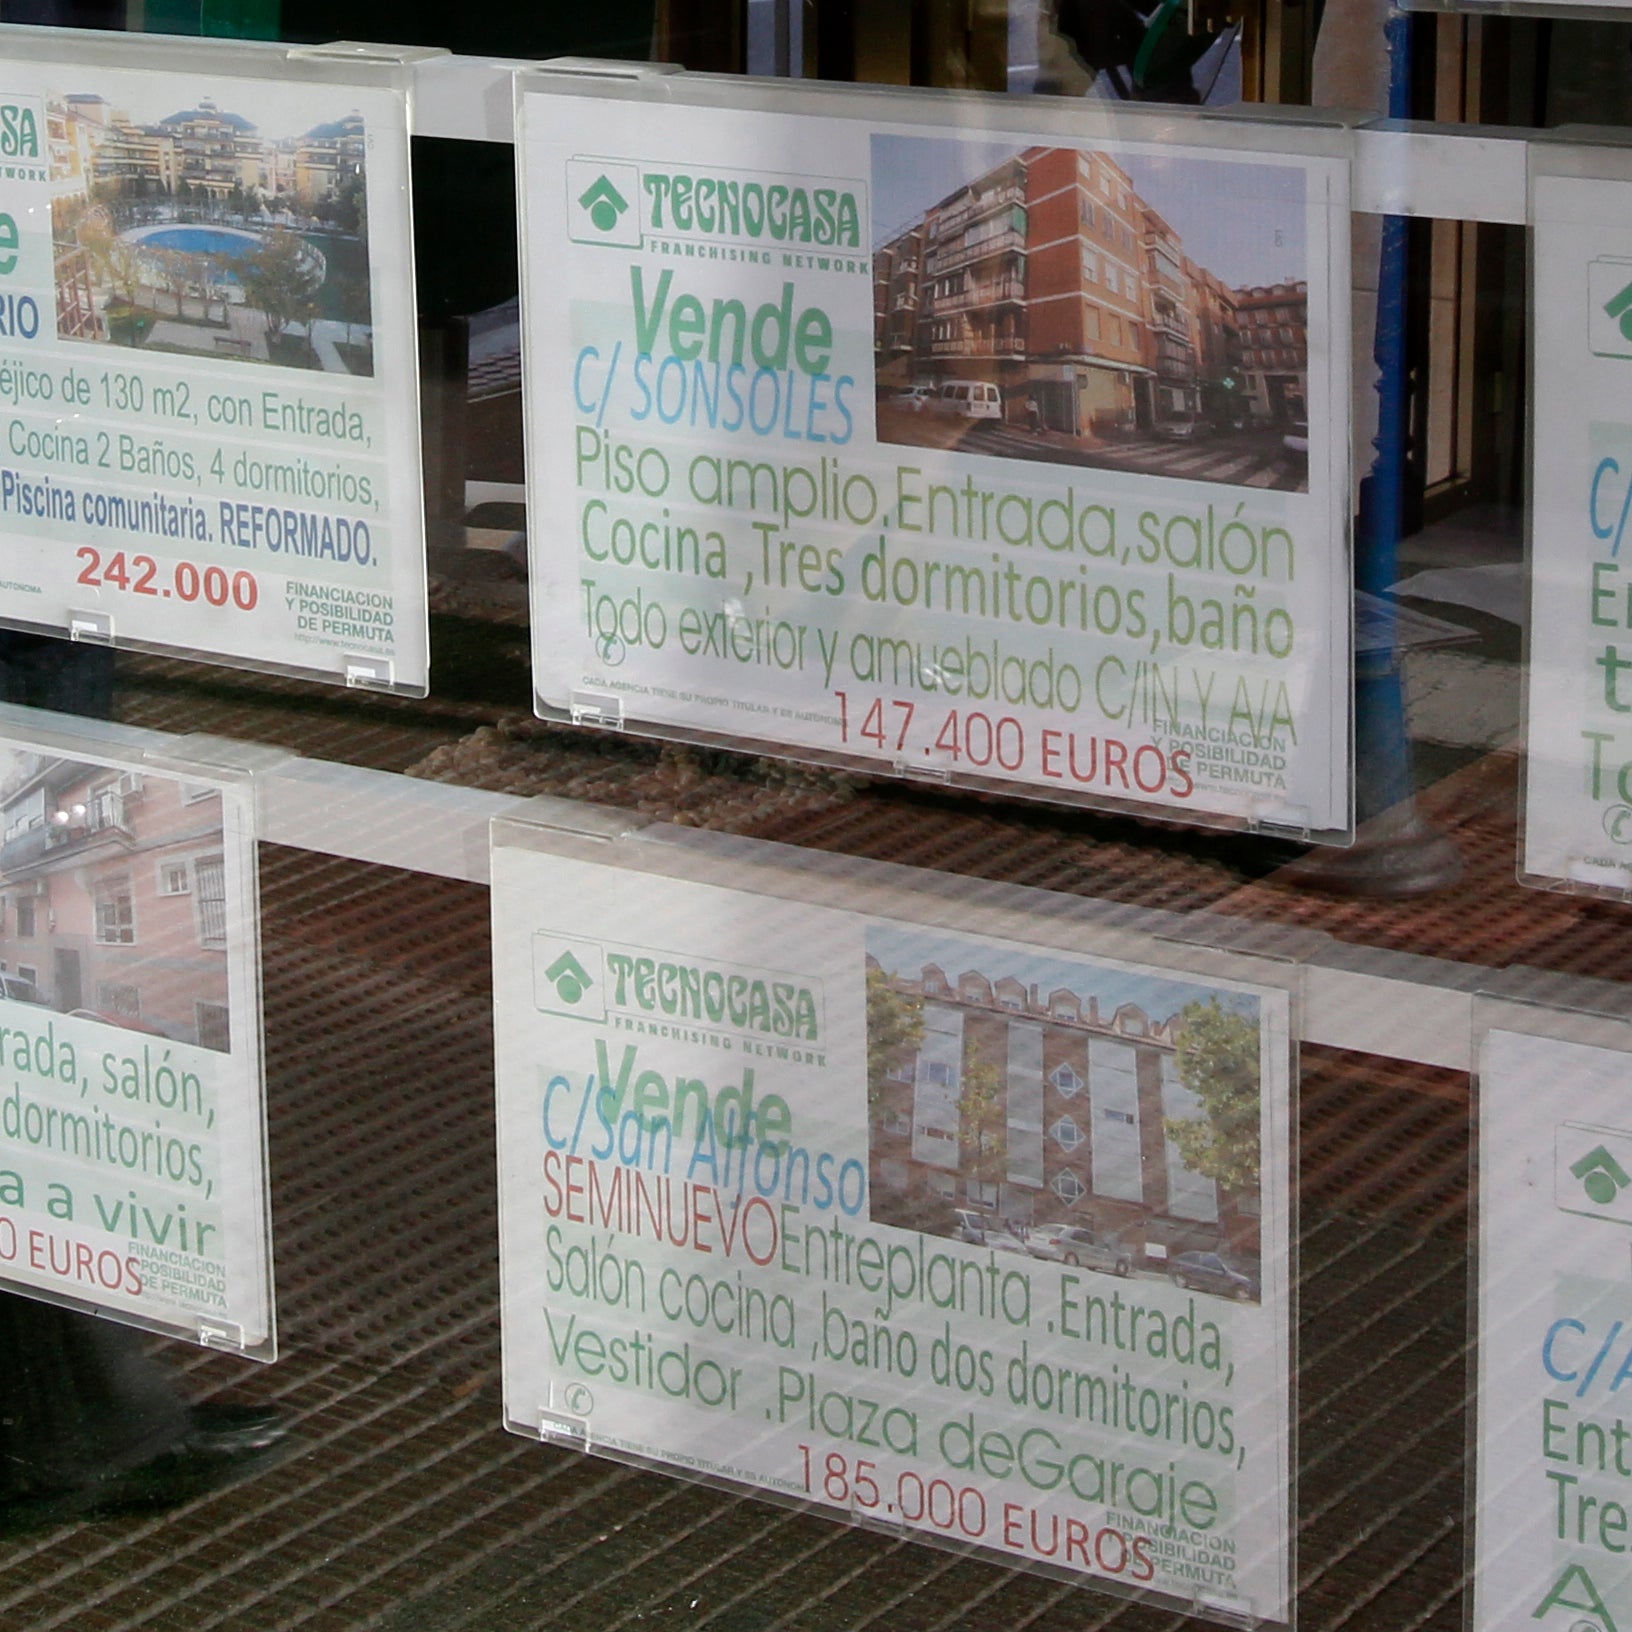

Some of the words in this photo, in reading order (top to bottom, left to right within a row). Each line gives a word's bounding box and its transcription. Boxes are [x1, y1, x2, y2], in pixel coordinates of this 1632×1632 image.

[100, 372, 143, 410] 130
[208, 391, 253, 426] con
[263, 393, 371, 447] Entrada,
[572, 340, 622, 428] C/
[630, 351, 855, 445] SONSOLES
[8, 417, 89, 465] Cocina
[119, 433, 202, 485] Baños,
[233, 449, 380, 512] dormitorios,
[576, 427, 670, 497] Piso
[2, 471, 75, 522] Piscina
[82, 485, 213, 542] comunitaria.
[219, 500, 378, 568] REFORMADO.
[581, 502, 727, 580] Cocina
[76, 546, 258, 612] 242.000
[285, 580, 393, 610] FINANCIACION
[298, 598, 393, 626] POSIBILIDAD
[316, 617, 394, 643] PERMUTA
[850, 630, 1081, 712] amueblado
[835, 691, 1024, 772] 147.400
[1042, 728, 1194, 799] EUROS
[102, 1048, 215, 1129] salón,
[3, 1079, 214, 1200] dormitorios,
[541, 1074, 672, 1170] C/San
[690, 1108, 865, 1217] Alfonso
[93, 1190, 216, 1256] vivir
[546, 1225, 647, 1313] Salón
[660, 1269, 796, 1352] cocina
[930, 1330, 994, 1390] dos
[1008, 1342, 1246, 1470] dormitorios,
[797, 1445, 985, 1539] 185.000
